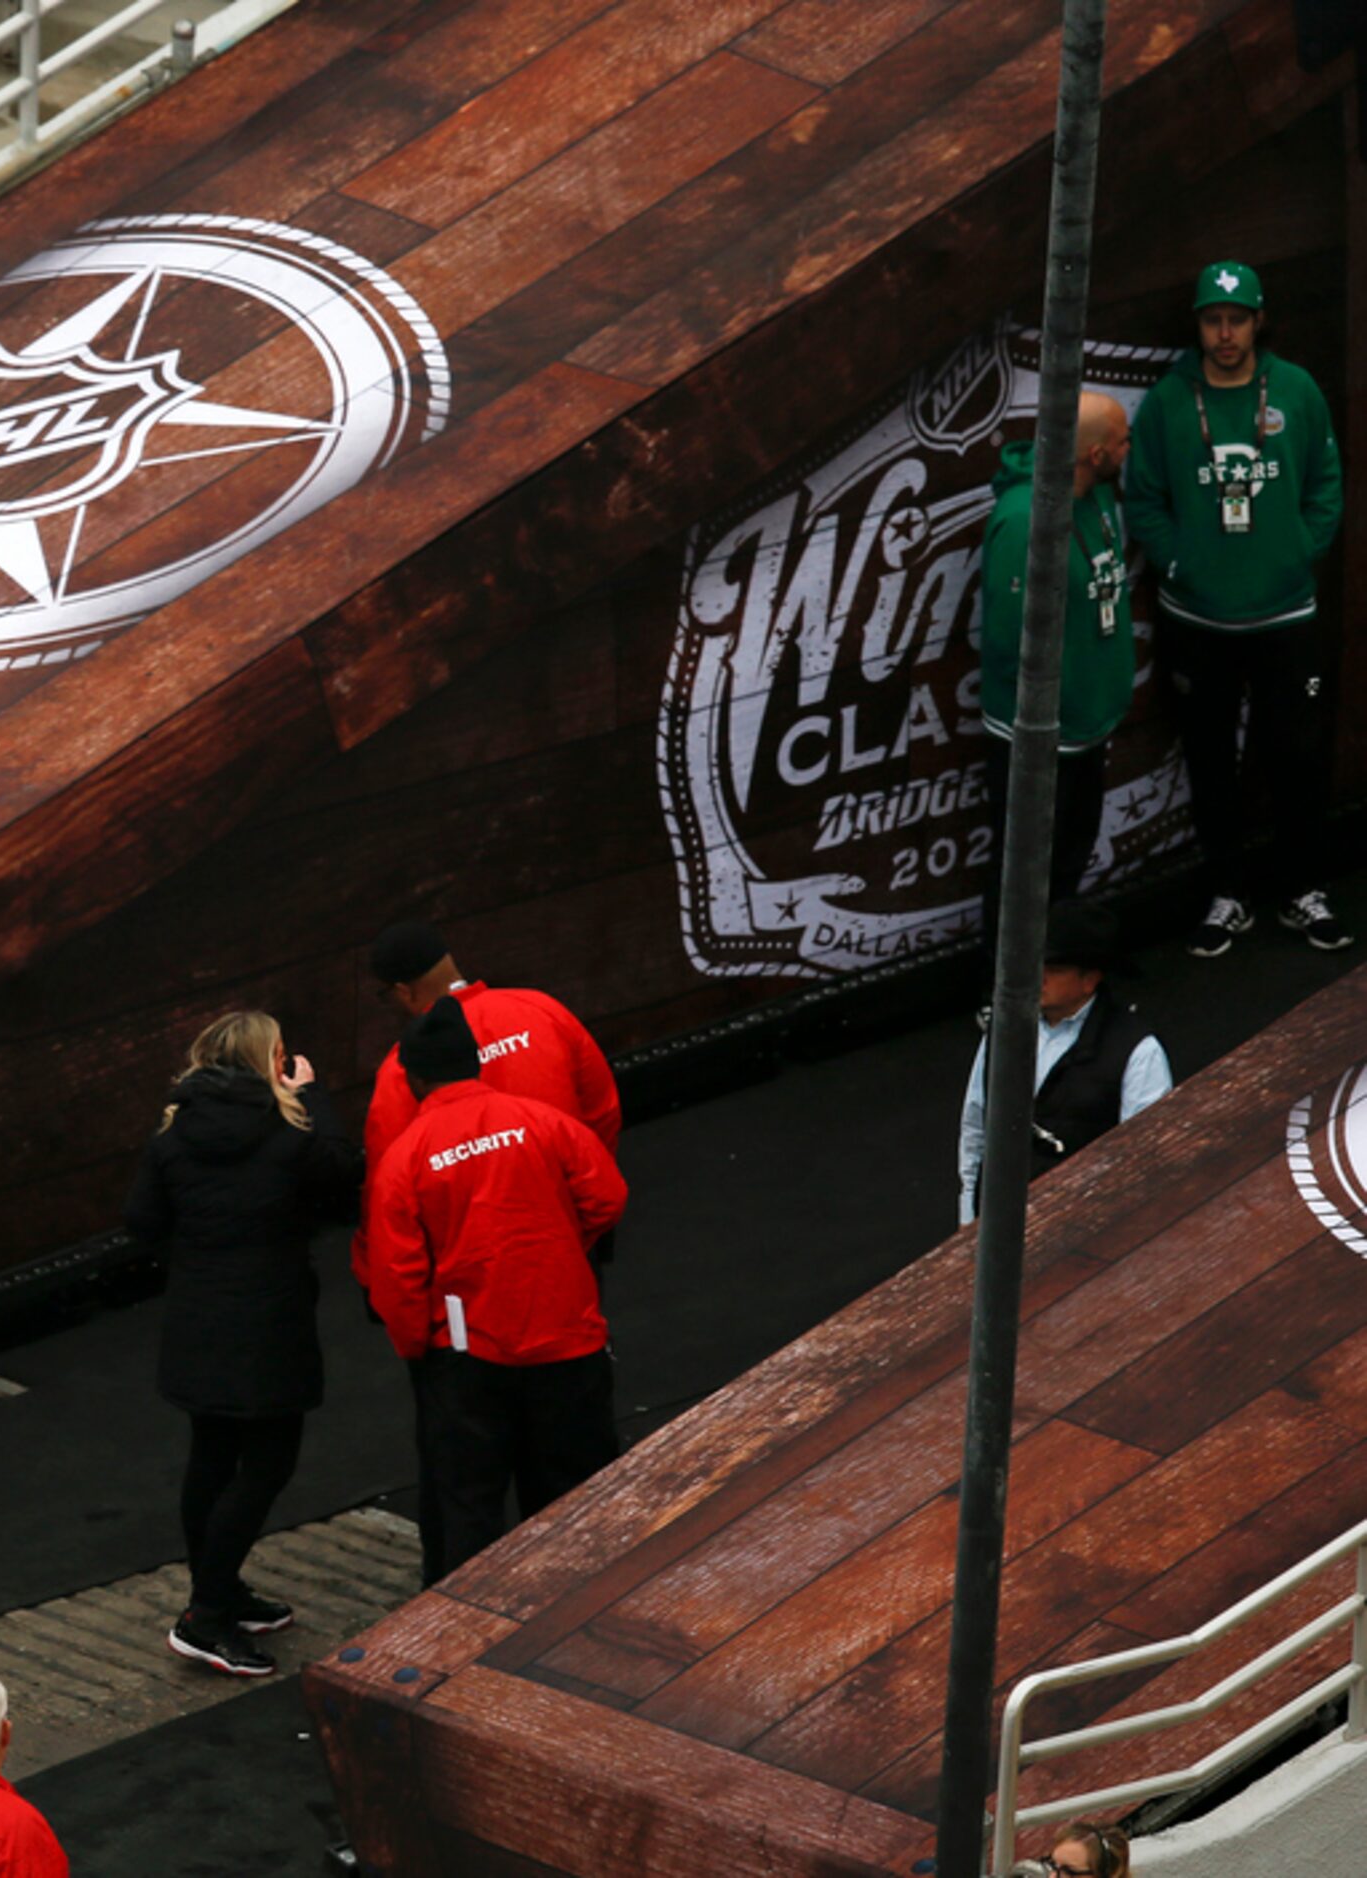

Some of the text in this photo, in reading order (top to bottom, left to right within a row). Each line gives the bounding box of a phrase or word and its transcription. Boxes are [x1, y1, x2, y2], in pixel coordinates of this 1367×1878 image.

[933, 336, 992, 424] NHL
[690, 458, 983, 814] Win
[776, 682, 984, 787] CLAS
[813, 761, 988, 851] BRIDGE
[889, 826, 992, 891] 202
[811, 923, 934, 958] DALLAS
[477, 1031, 530, 1065] URITY
[428, 1126, 527, 1172] SECURITY
